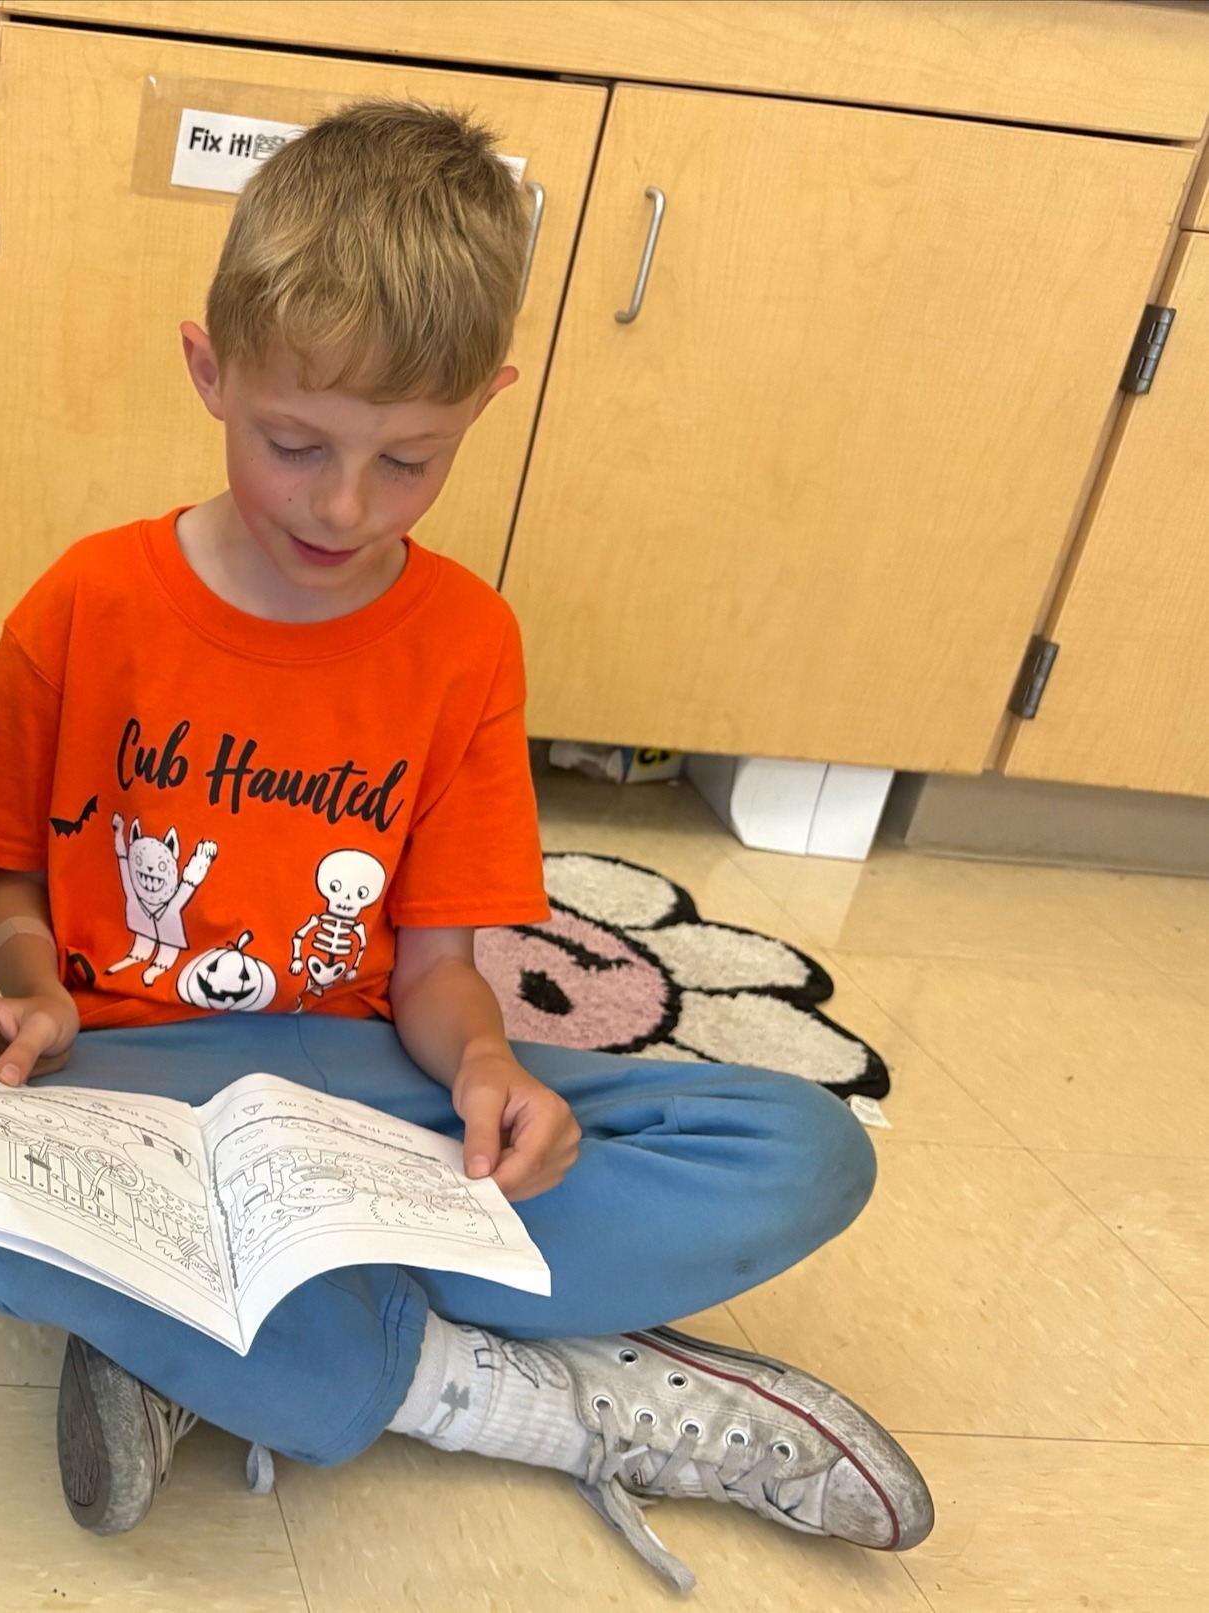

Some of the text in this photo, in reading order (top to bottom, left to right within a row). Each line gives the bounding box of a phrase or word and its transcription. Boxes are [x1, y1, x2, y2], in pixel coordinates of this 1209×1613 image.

[189, 126, 253, 158] Fix it!
[116, 718, 409, 833] Cub Haunted
